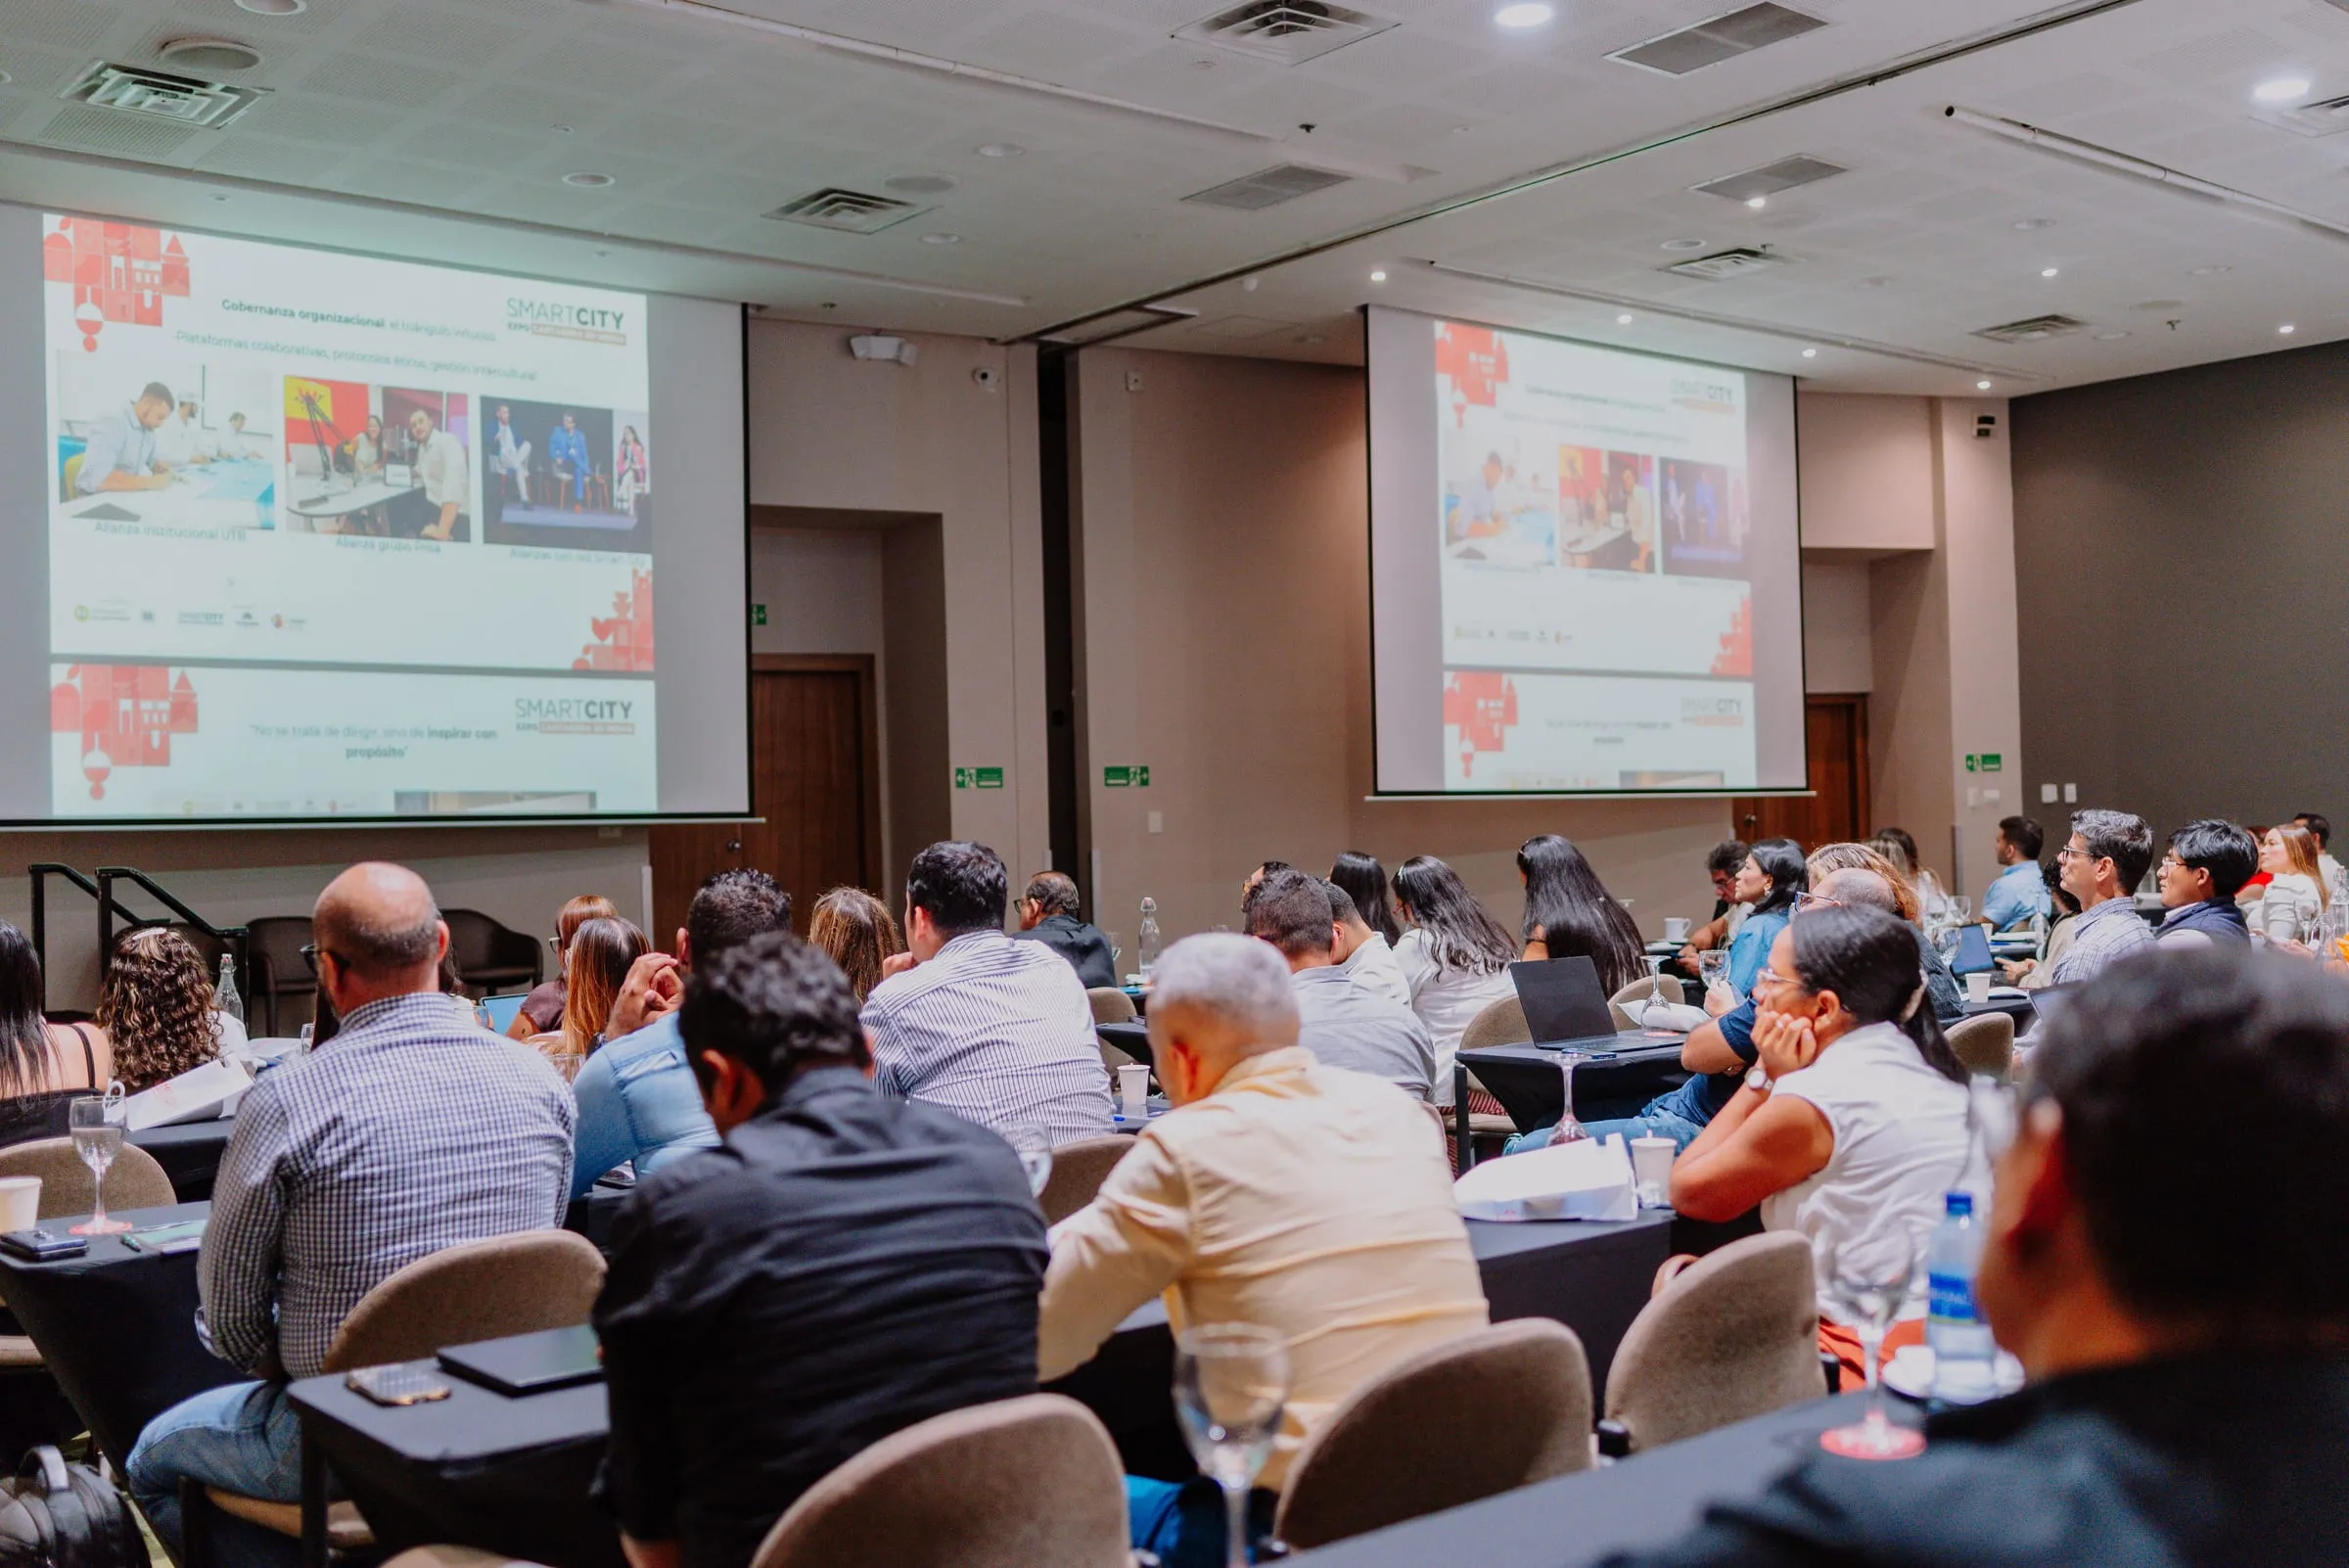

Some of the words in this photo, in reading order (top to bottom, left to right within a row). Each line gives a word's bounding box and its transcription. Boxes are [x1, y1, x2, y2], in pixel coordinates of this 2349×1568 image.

[221, 299, 296, 318] Gobernanza
[428, 727, 472, 742] inspirar
[476, 729, 497, 740] con
